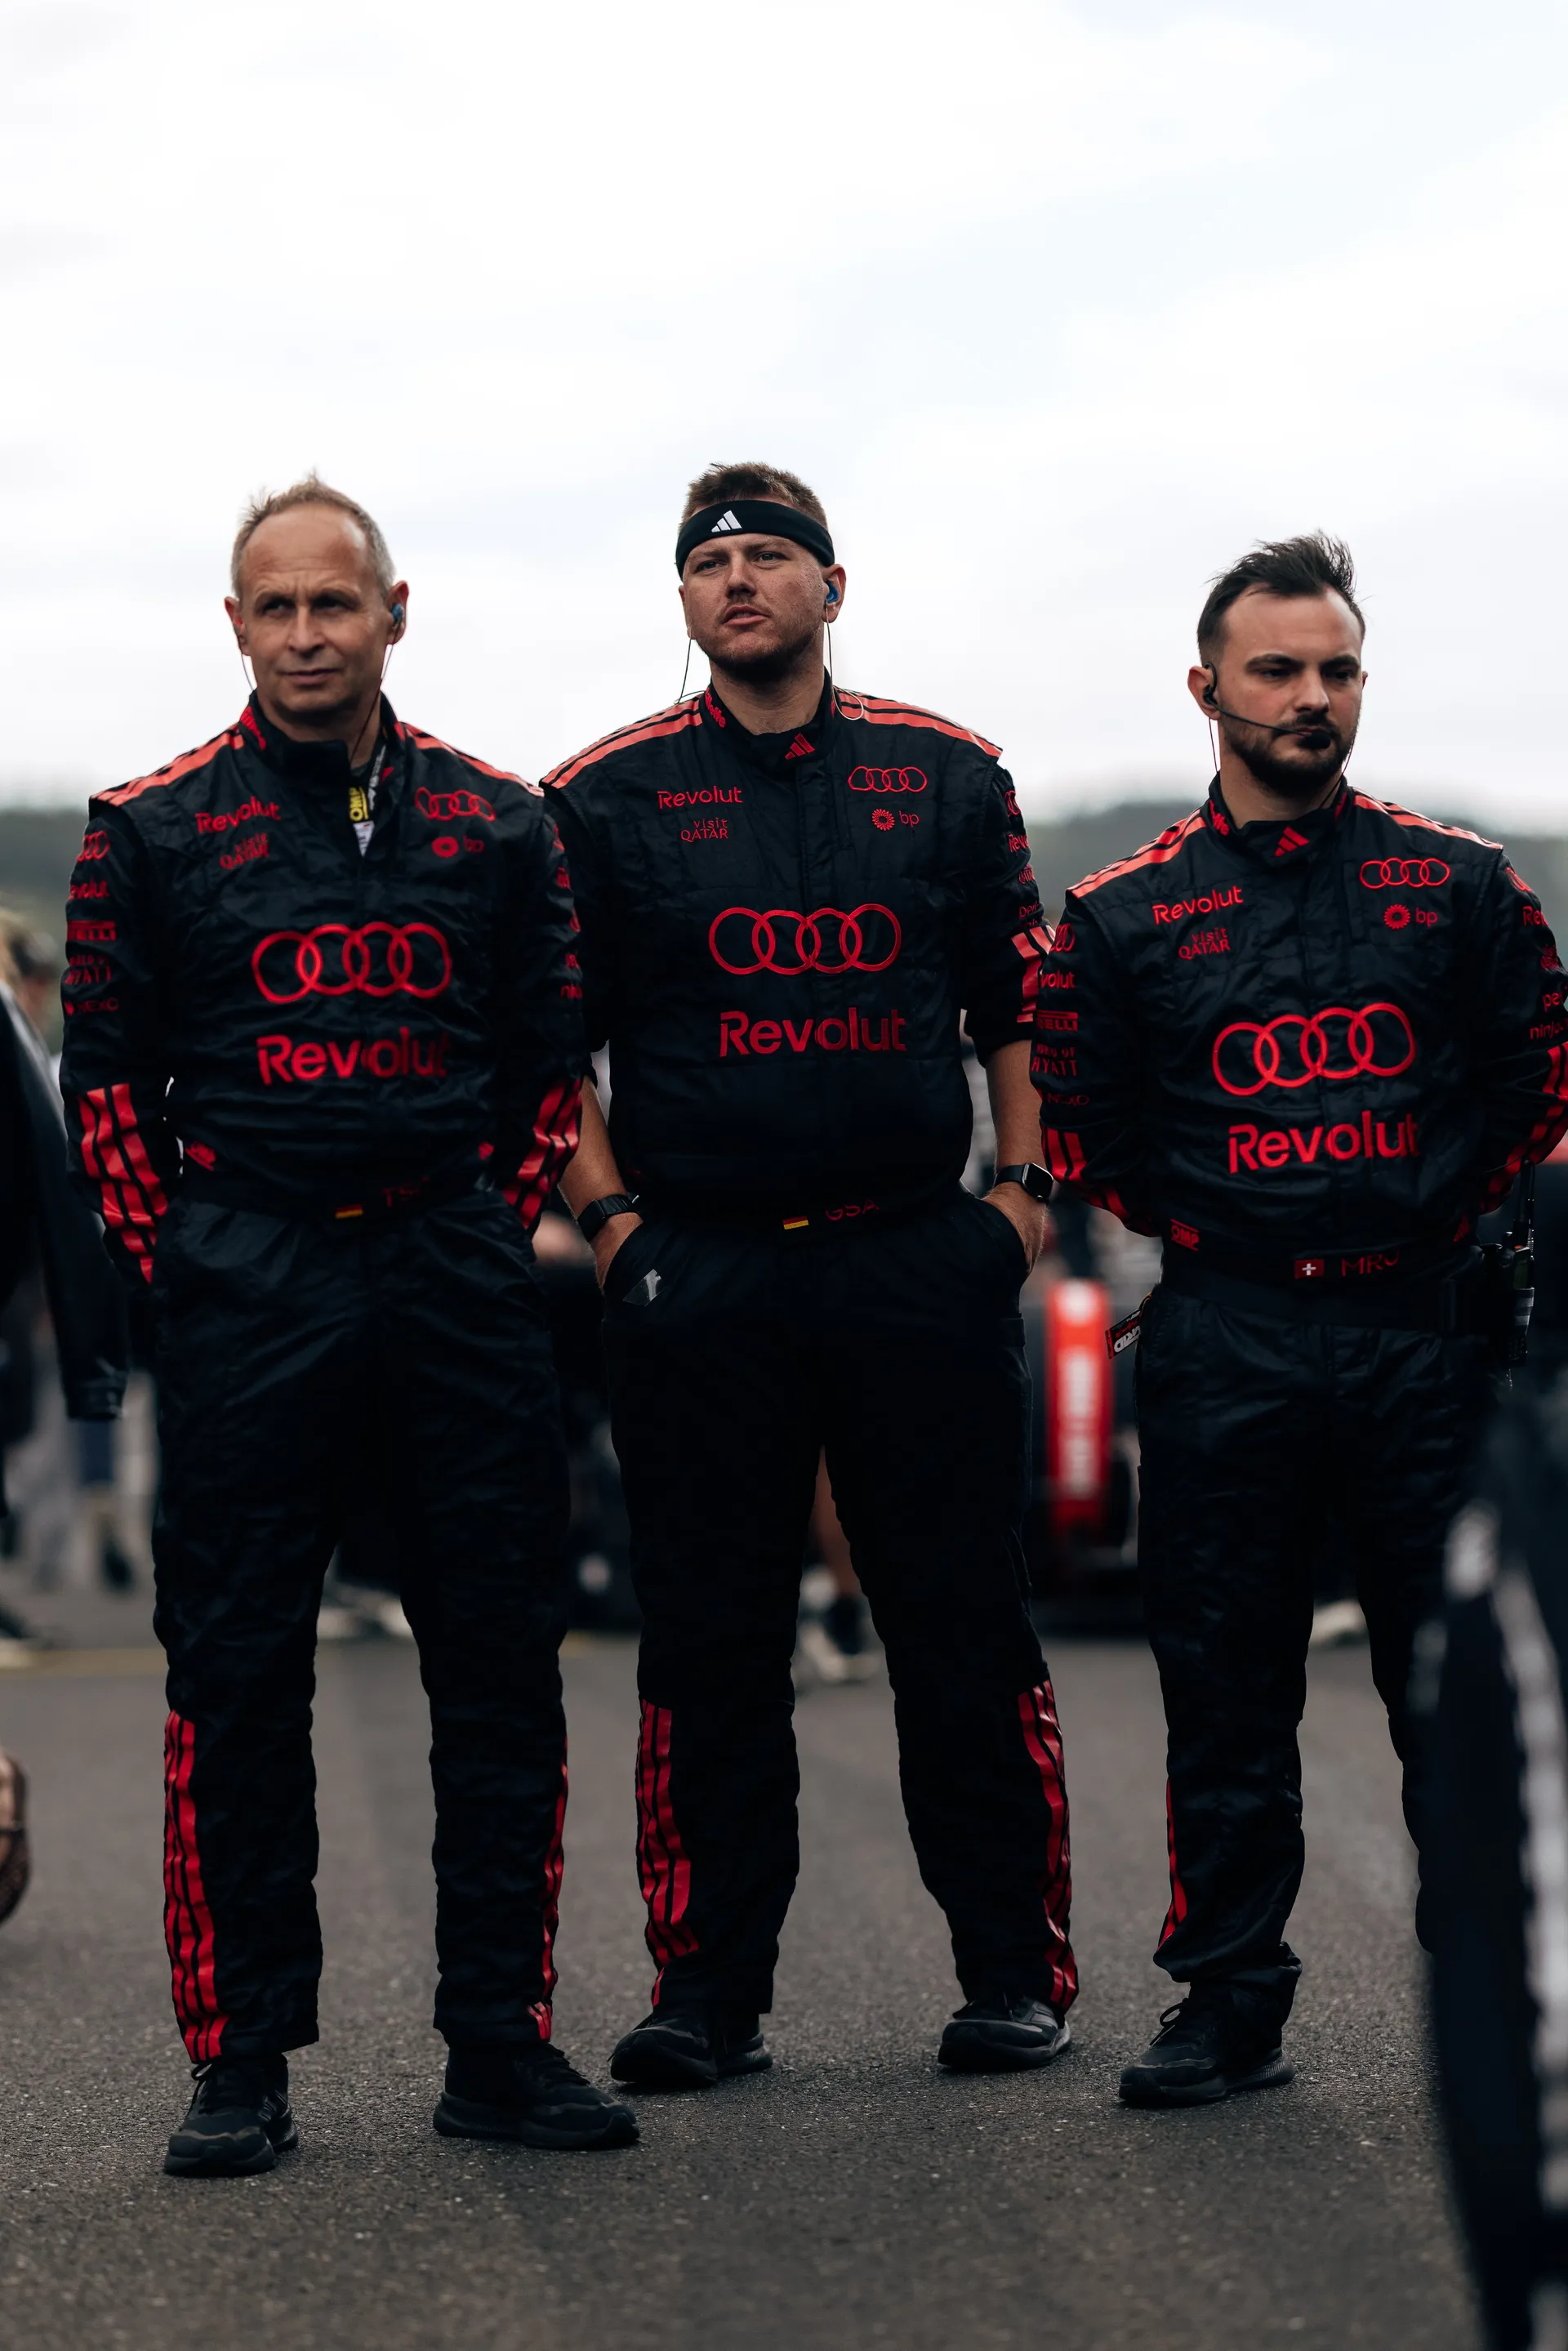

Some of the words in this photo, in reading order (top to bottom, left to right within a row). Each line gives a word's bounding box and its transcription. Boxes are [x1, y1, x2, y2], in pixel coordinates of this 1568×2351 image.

[657, 785, 743, 810] Revolut
[194, 796, 282, 835] Revolut
[693, 817, 728, 829] visit
[899, 810, 920, 828] bp
[680, 828, 729, 843] QATAR
[1152, 885, 1244, 926] Revolut
[1415, 907, 1438, 928] bp
[1178, 939, 1231, 961] QATAR
[719, 1006, 907, 1059] Revolut
[256, 1025, 447, 1086] Revolut
[1031, 1055, 1077, 1077] HYATT
[1228, 1110, 1419, 1175] Revolut
